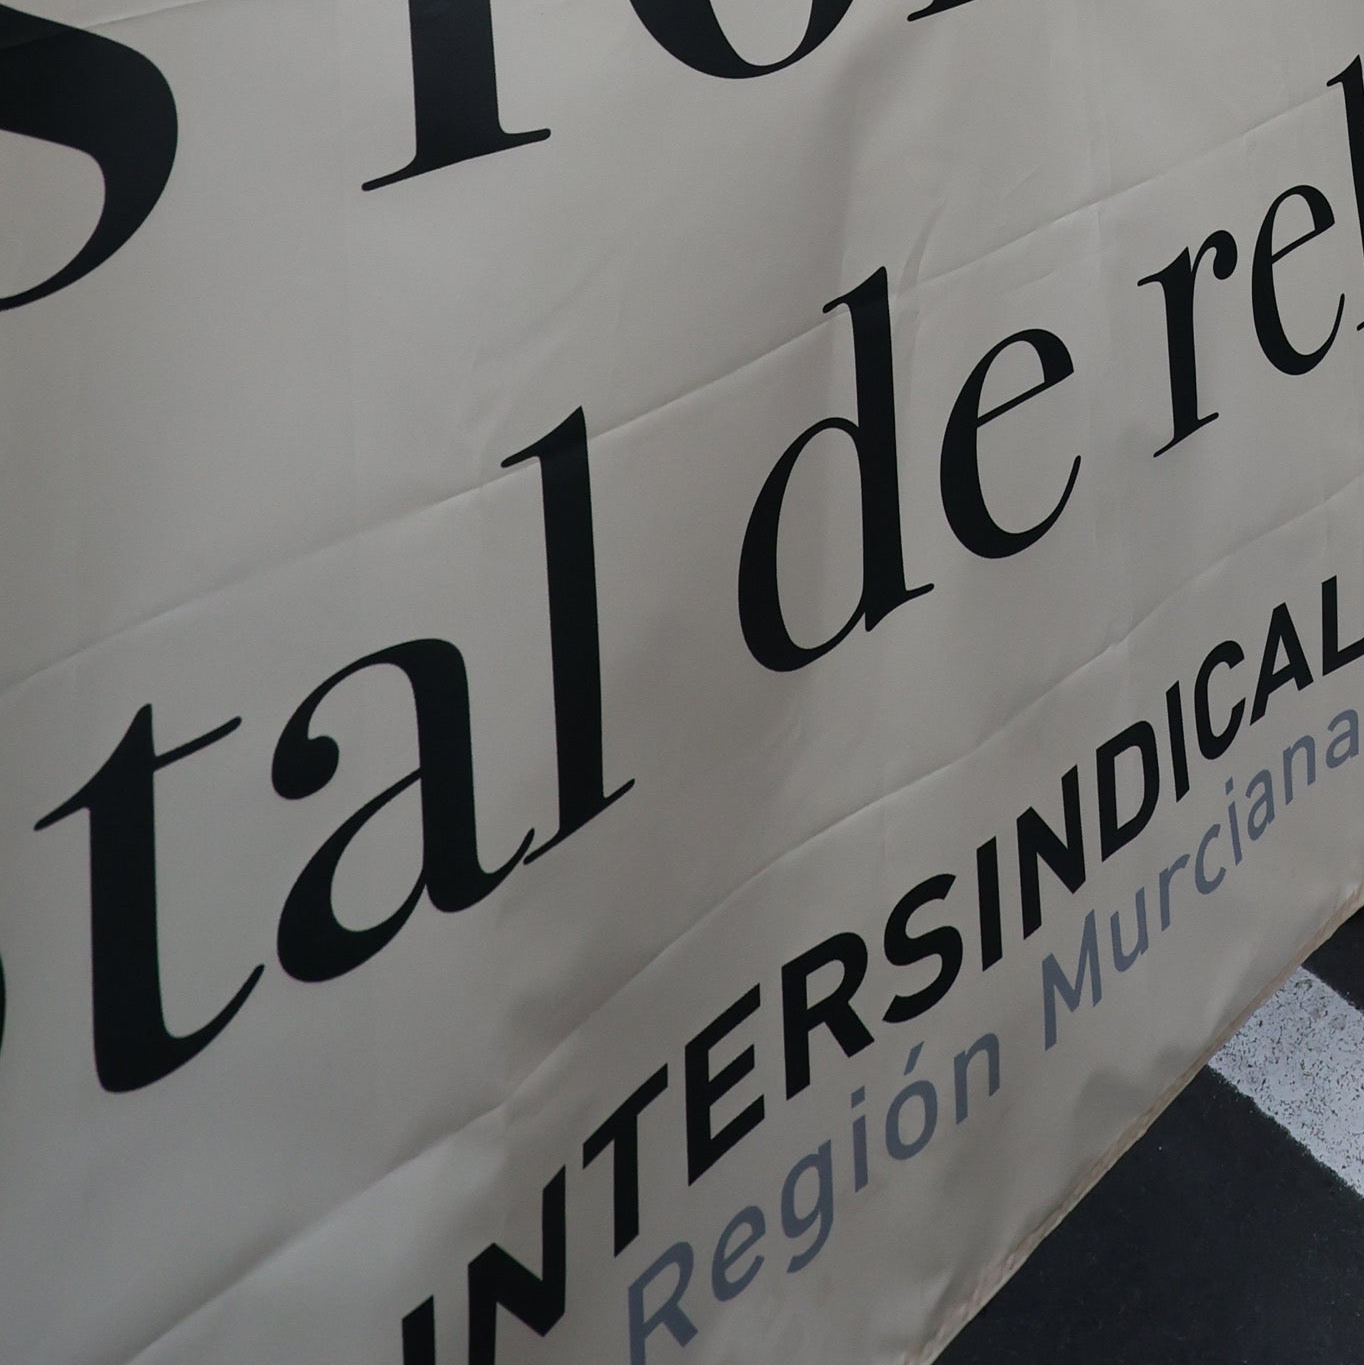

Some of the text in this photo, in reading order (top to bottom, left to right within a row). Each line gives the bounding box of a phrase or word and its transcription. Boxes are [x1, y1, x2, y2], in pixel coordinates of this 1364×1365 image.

[0, 405, 635, 1093] tal
[738, 265, 1082, 672] de
[628, 709, 1360, 1365] Región Murciana
